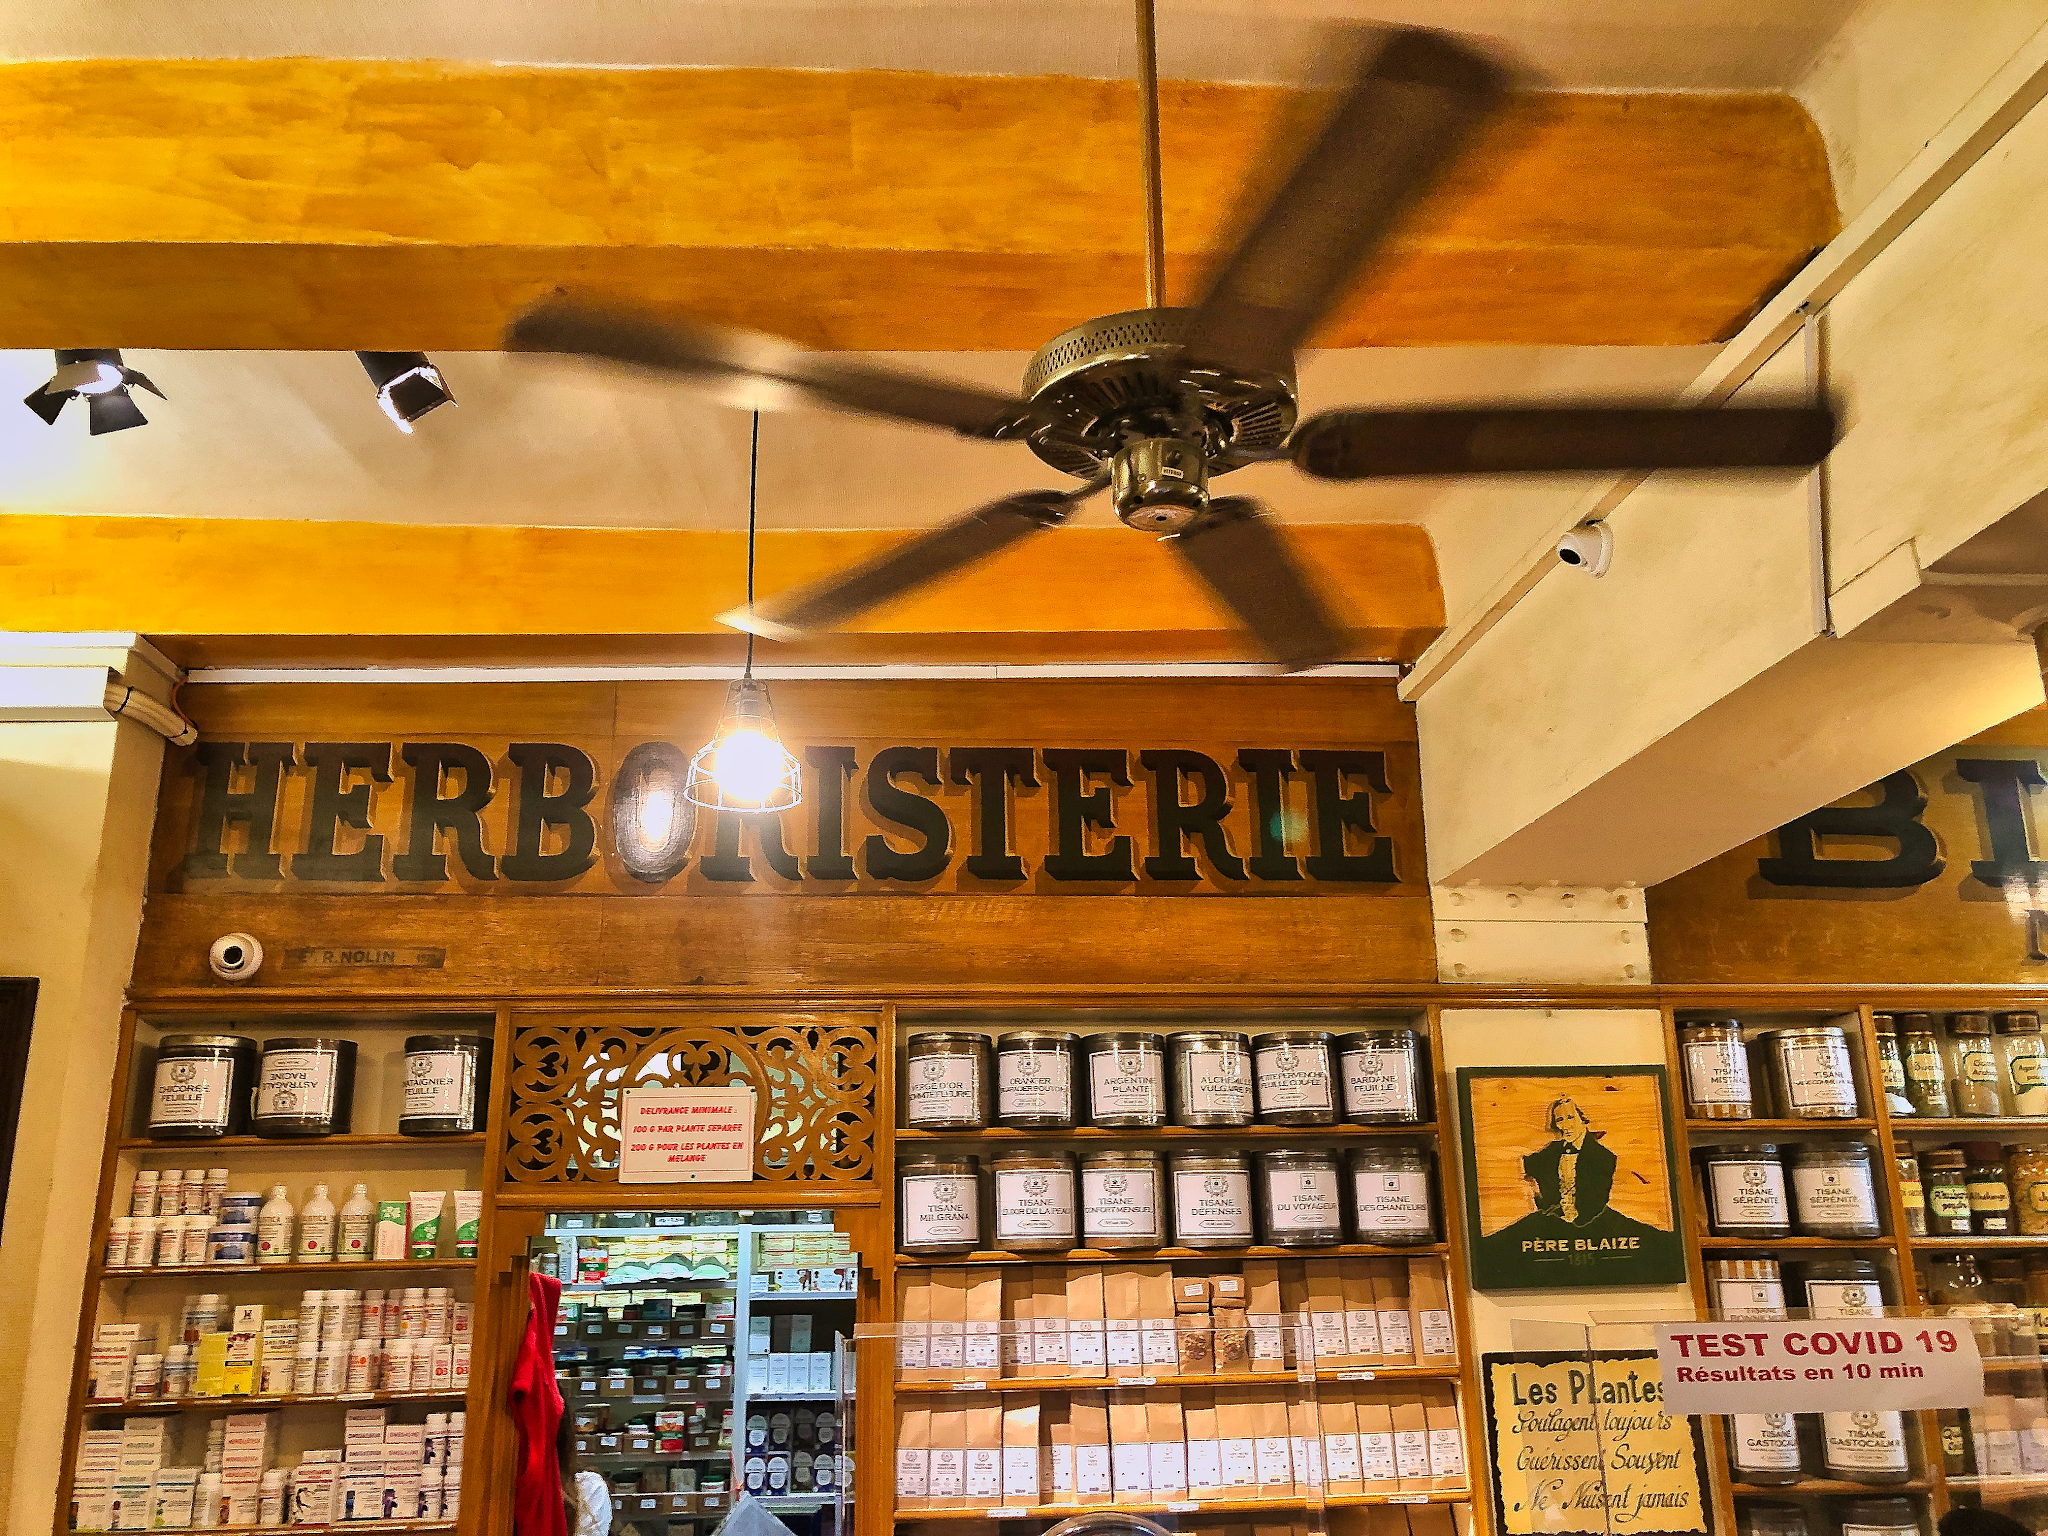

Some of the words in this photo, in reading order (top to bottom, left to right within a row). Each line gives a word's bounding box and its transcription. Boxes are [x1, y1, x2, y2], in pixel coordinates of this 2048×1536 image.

[186, 741, 1401, 883] HERBORISTERIE
[691, 1105, 733, 1114] MINIMALE
[633, 1125, 647, 1133] 100
[658, 1125, 674, 1133] PAR
[676, 1124, 705, 1133] PLANTE
[631, 1143, 646, 1151] 200
[657, 1143, 678, 1151] POUR
[696, 1142, 731, 1150] PLANTES
[1738, 1187, 1774, 1196] TISANE
[1815, 1187, 1852, 1196] TISANE
[1018, 1199, 1054, 1207] TISANE
[1098, 1198, 1134, 1206] TISANE
[1199, 1199, 1235, 1207] TISANE
[1292, 1194, 1326, 1203] TISANE
[1375, 1195, 1411, 1203] TISANE
[927, 1204, 963, 1213] TISANE
[1277, 1203, 1290, 1211] DU
[1293, 1202, 1337, 1211] VOYAGEUR
[1376, 1203, 1426, 1211] CHANTEURS
[1521, 1236, 1569, 1253] PÈRE
[1574, 1237, 1640, 1251] BLAIZE
[1838, 1308, 1874, 1316] TISANE
[1670, 1332, 1768, 1358] TEST
[1783, 1331, 1903, 1356] COVID
[1915, 1330, 1958, 1353] 19
[1676, 1363, 1796, 1383] Résultats
[1804, 1367, 1834, 1380] en
[1842, 1363, 1871, 1379] 10
[1880, 1362, 1924, 1379] min
[1511, 1372, 1558, 1406] Les
[1761, 1430, 1792, 1438] TISANE
[1846, 1430, 1887, 1439] TISANE
